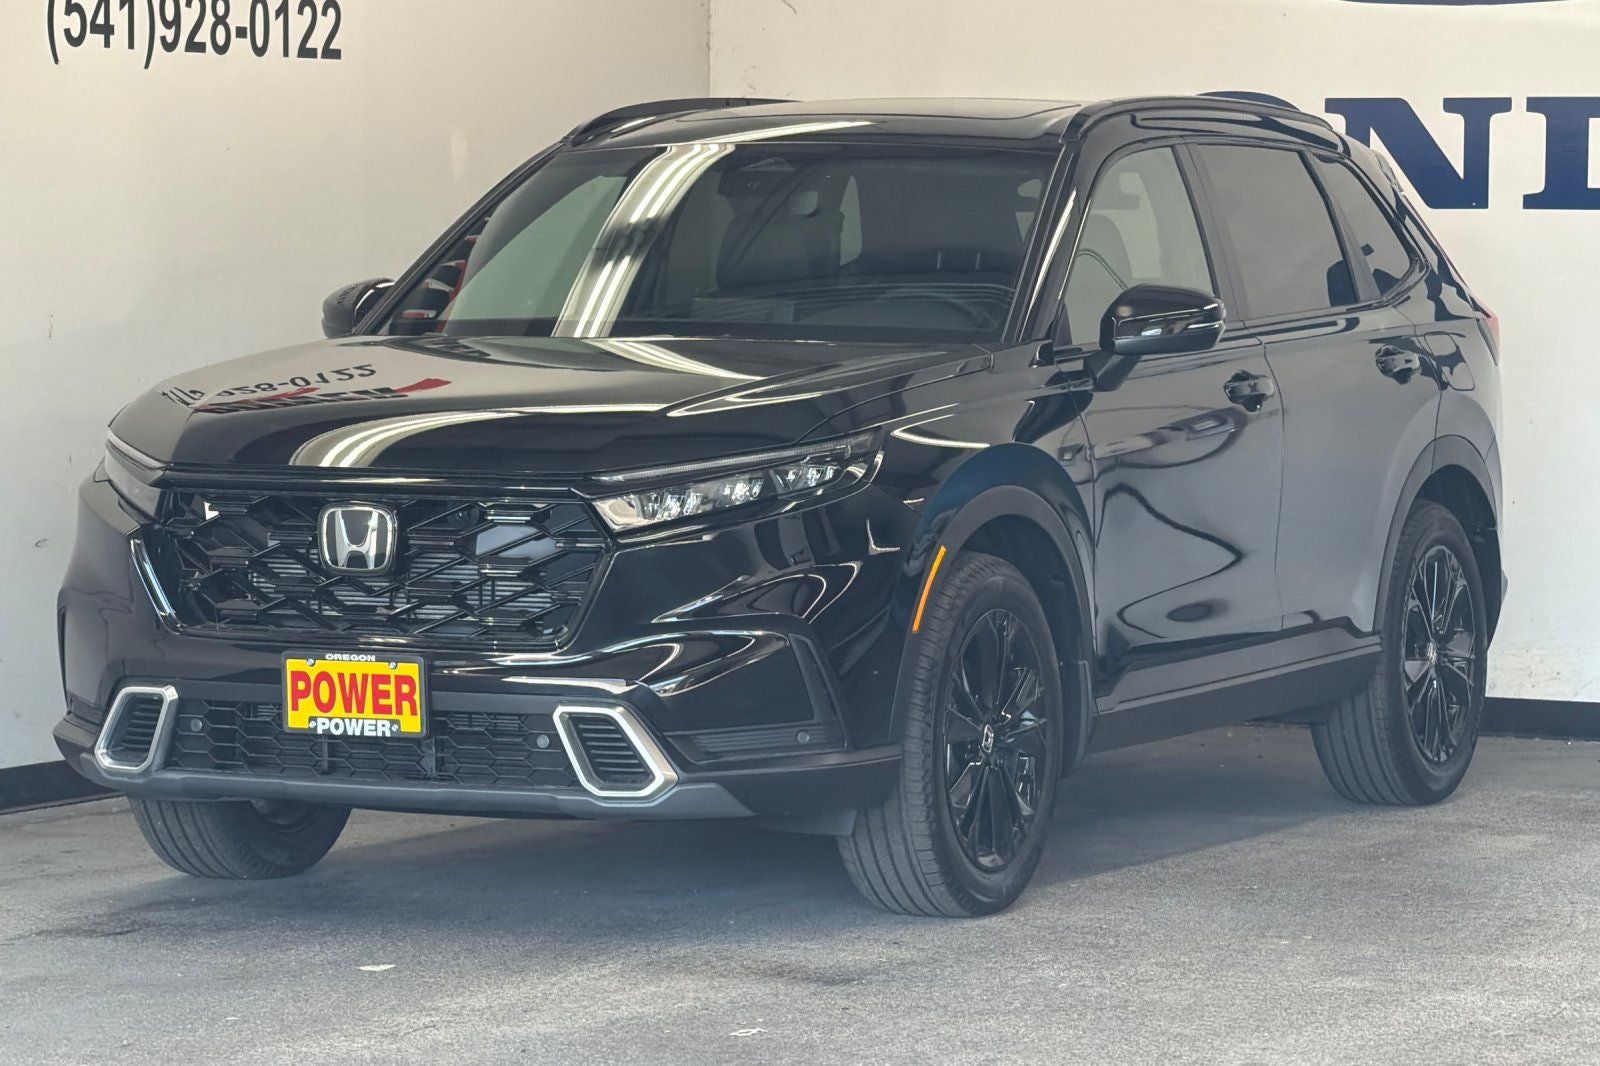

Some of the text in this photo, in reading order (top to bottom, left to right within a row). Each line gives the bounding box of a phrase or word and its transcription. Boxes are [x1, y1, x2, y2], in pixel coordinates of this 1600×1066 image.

[47, 0, 342, 69] (541)928-0122
[325, 653, 376, 662] OREGON
[290, 670, 418, 717] POWER
[316, 717, 391, 738] POWER
